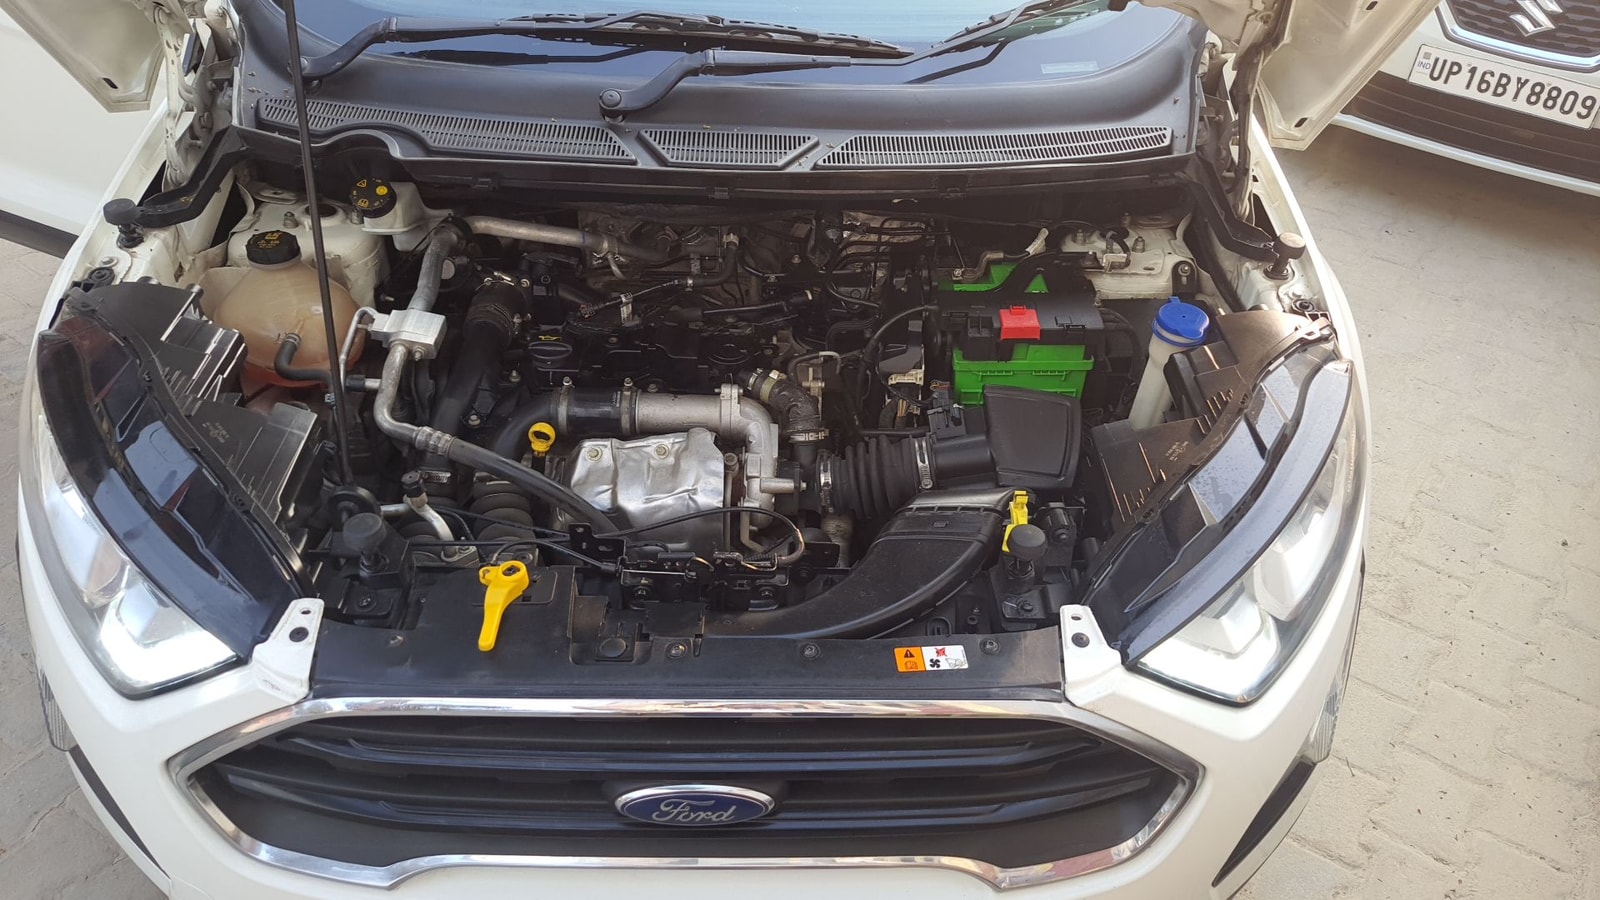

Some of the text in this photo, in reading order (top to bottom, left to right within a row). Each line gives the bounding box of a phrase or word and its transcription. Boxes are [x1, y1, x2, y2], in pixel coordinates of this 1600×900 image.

[1417, 60, 1431, 70] IND
[1429, 57, 1597, 120] UP16BY8809
[652, 798, 737, 822] Ford
